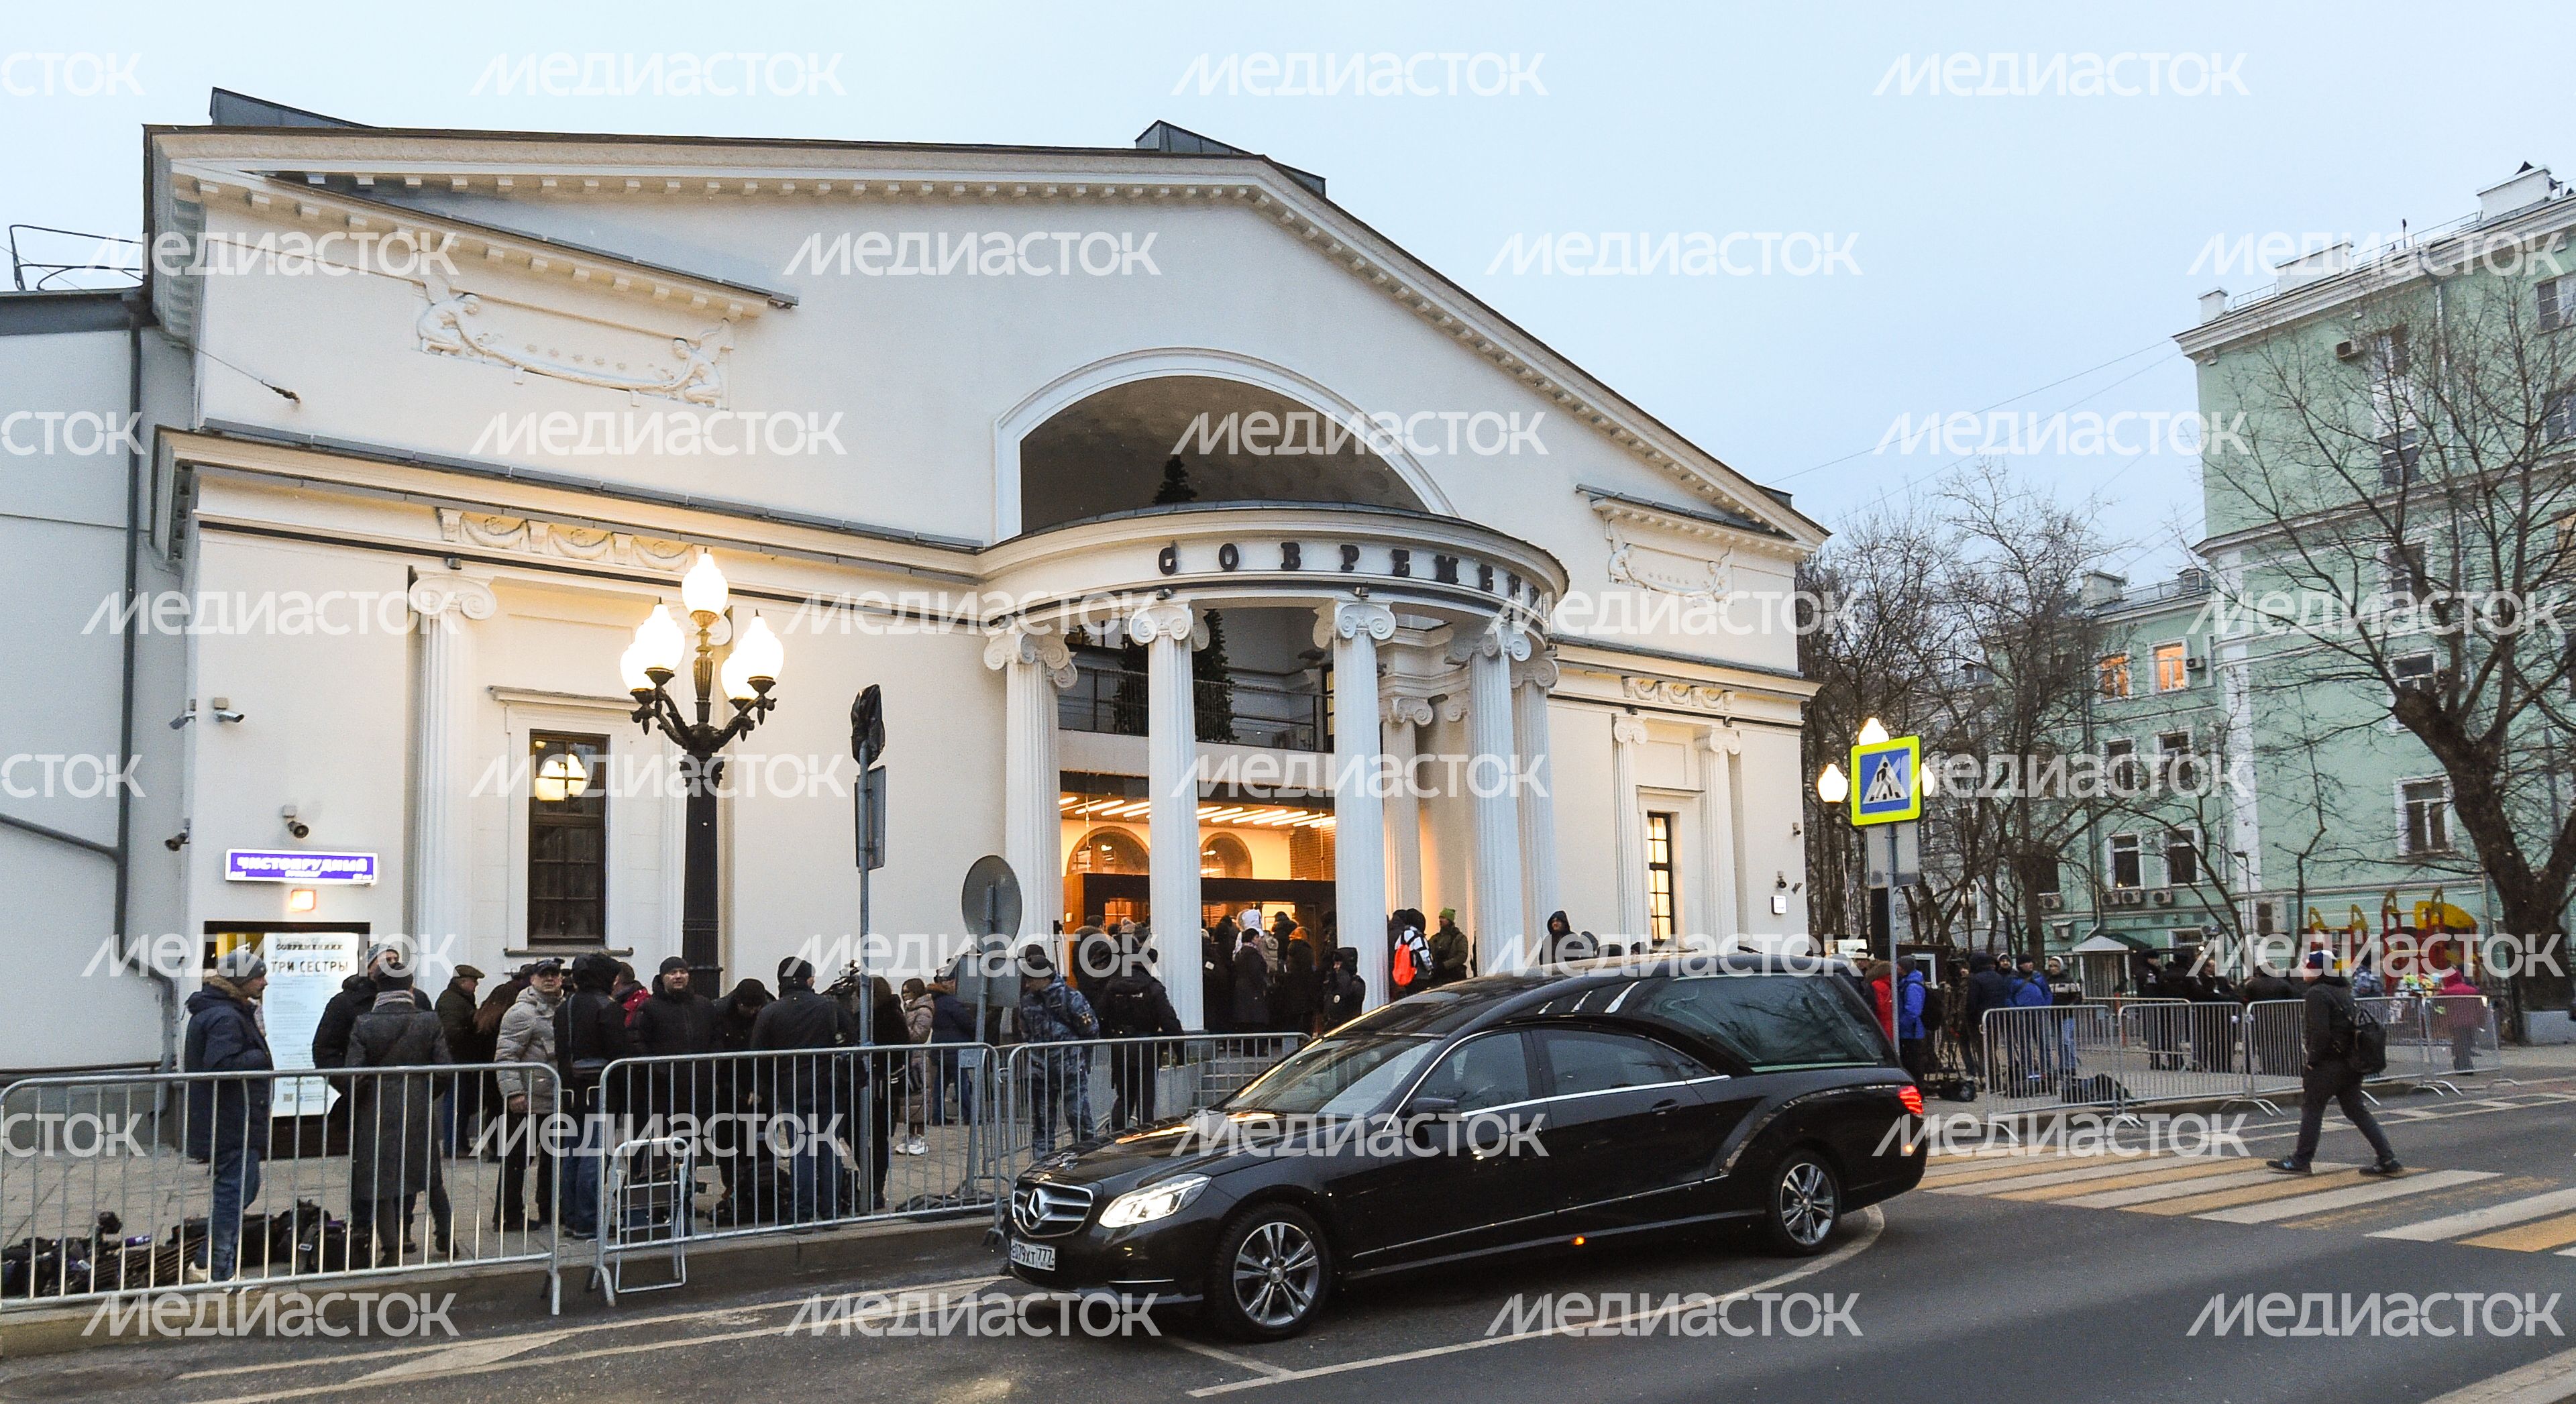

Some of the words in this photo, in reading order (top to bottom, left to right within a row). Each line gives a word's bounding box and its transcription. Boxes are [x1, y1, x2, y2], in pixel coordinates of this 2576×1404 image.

[270, 961, 294, 973] ТРИ
[299, 961, 349, 973] СЕСТРЫ
[1036, 1248, 1053, 1263] 777
